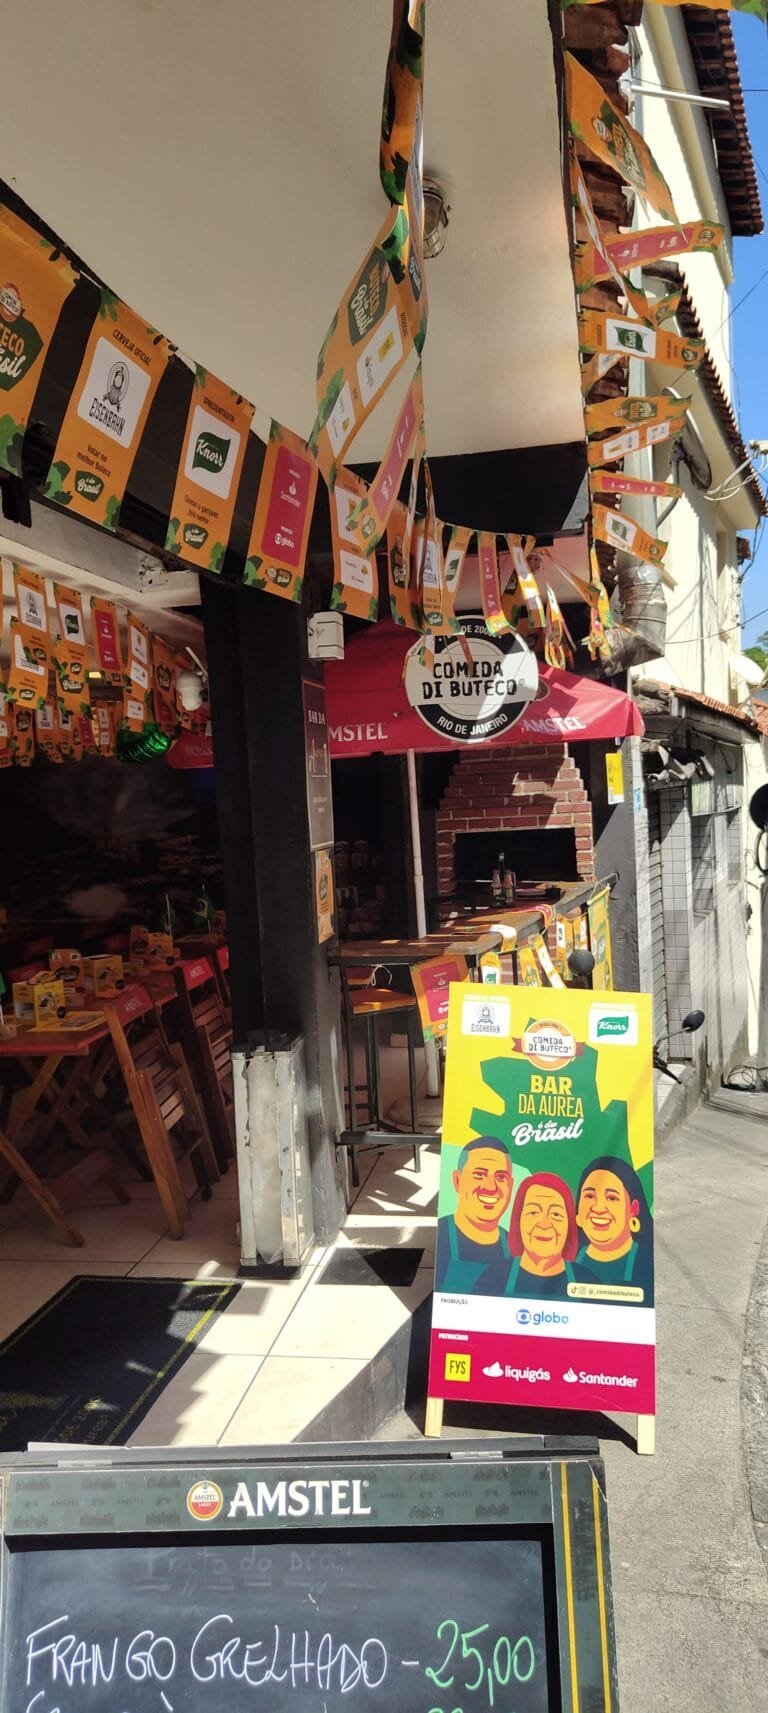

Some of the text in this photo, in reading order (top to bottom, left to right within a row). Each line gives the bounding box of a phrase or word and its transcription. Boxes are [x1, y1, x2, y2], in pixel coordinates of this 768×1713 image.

[113, 329, 152, 366] CERVEJA OFICIAL
[88, 397, 126, 437] EISENBAHN
[197, 439, 224, 467] Knorr
[433, 660, 504, 679] COMIDA
[422, 679, 517, 699] DI BUTECO
[328, 722, 388, 742] MSTEL
[437, 713, 508, 735] RIO DE JANEIRO
[523, 716, 587, 735] AMSTEL
[471, 1023, 500, 1034] EISENBAHN
[598, 1021, 627, 1032] Knorr
[528, 1043, 569, 1054] DI BUTECO
[533, 1036, 563, 1045] COMIDA
[530, 1074, 573, 1096] BAR
[518, 1093, 584, 1119] DA AUREA
[511, 1118, 585, 1147] Brasil
[544, 1120, 558, 1129] do
[532, 1310, 569, 1326] globo
[449, 1360, 467, 1375] FYS
[504, 1364, 638, 1388] liquigás Santander
[227, 1480, 371, 1517] AMSTEL
[190, 1614, 388, 1694] GRELHADO
[425, 1619, 536, 1707] 25,00
